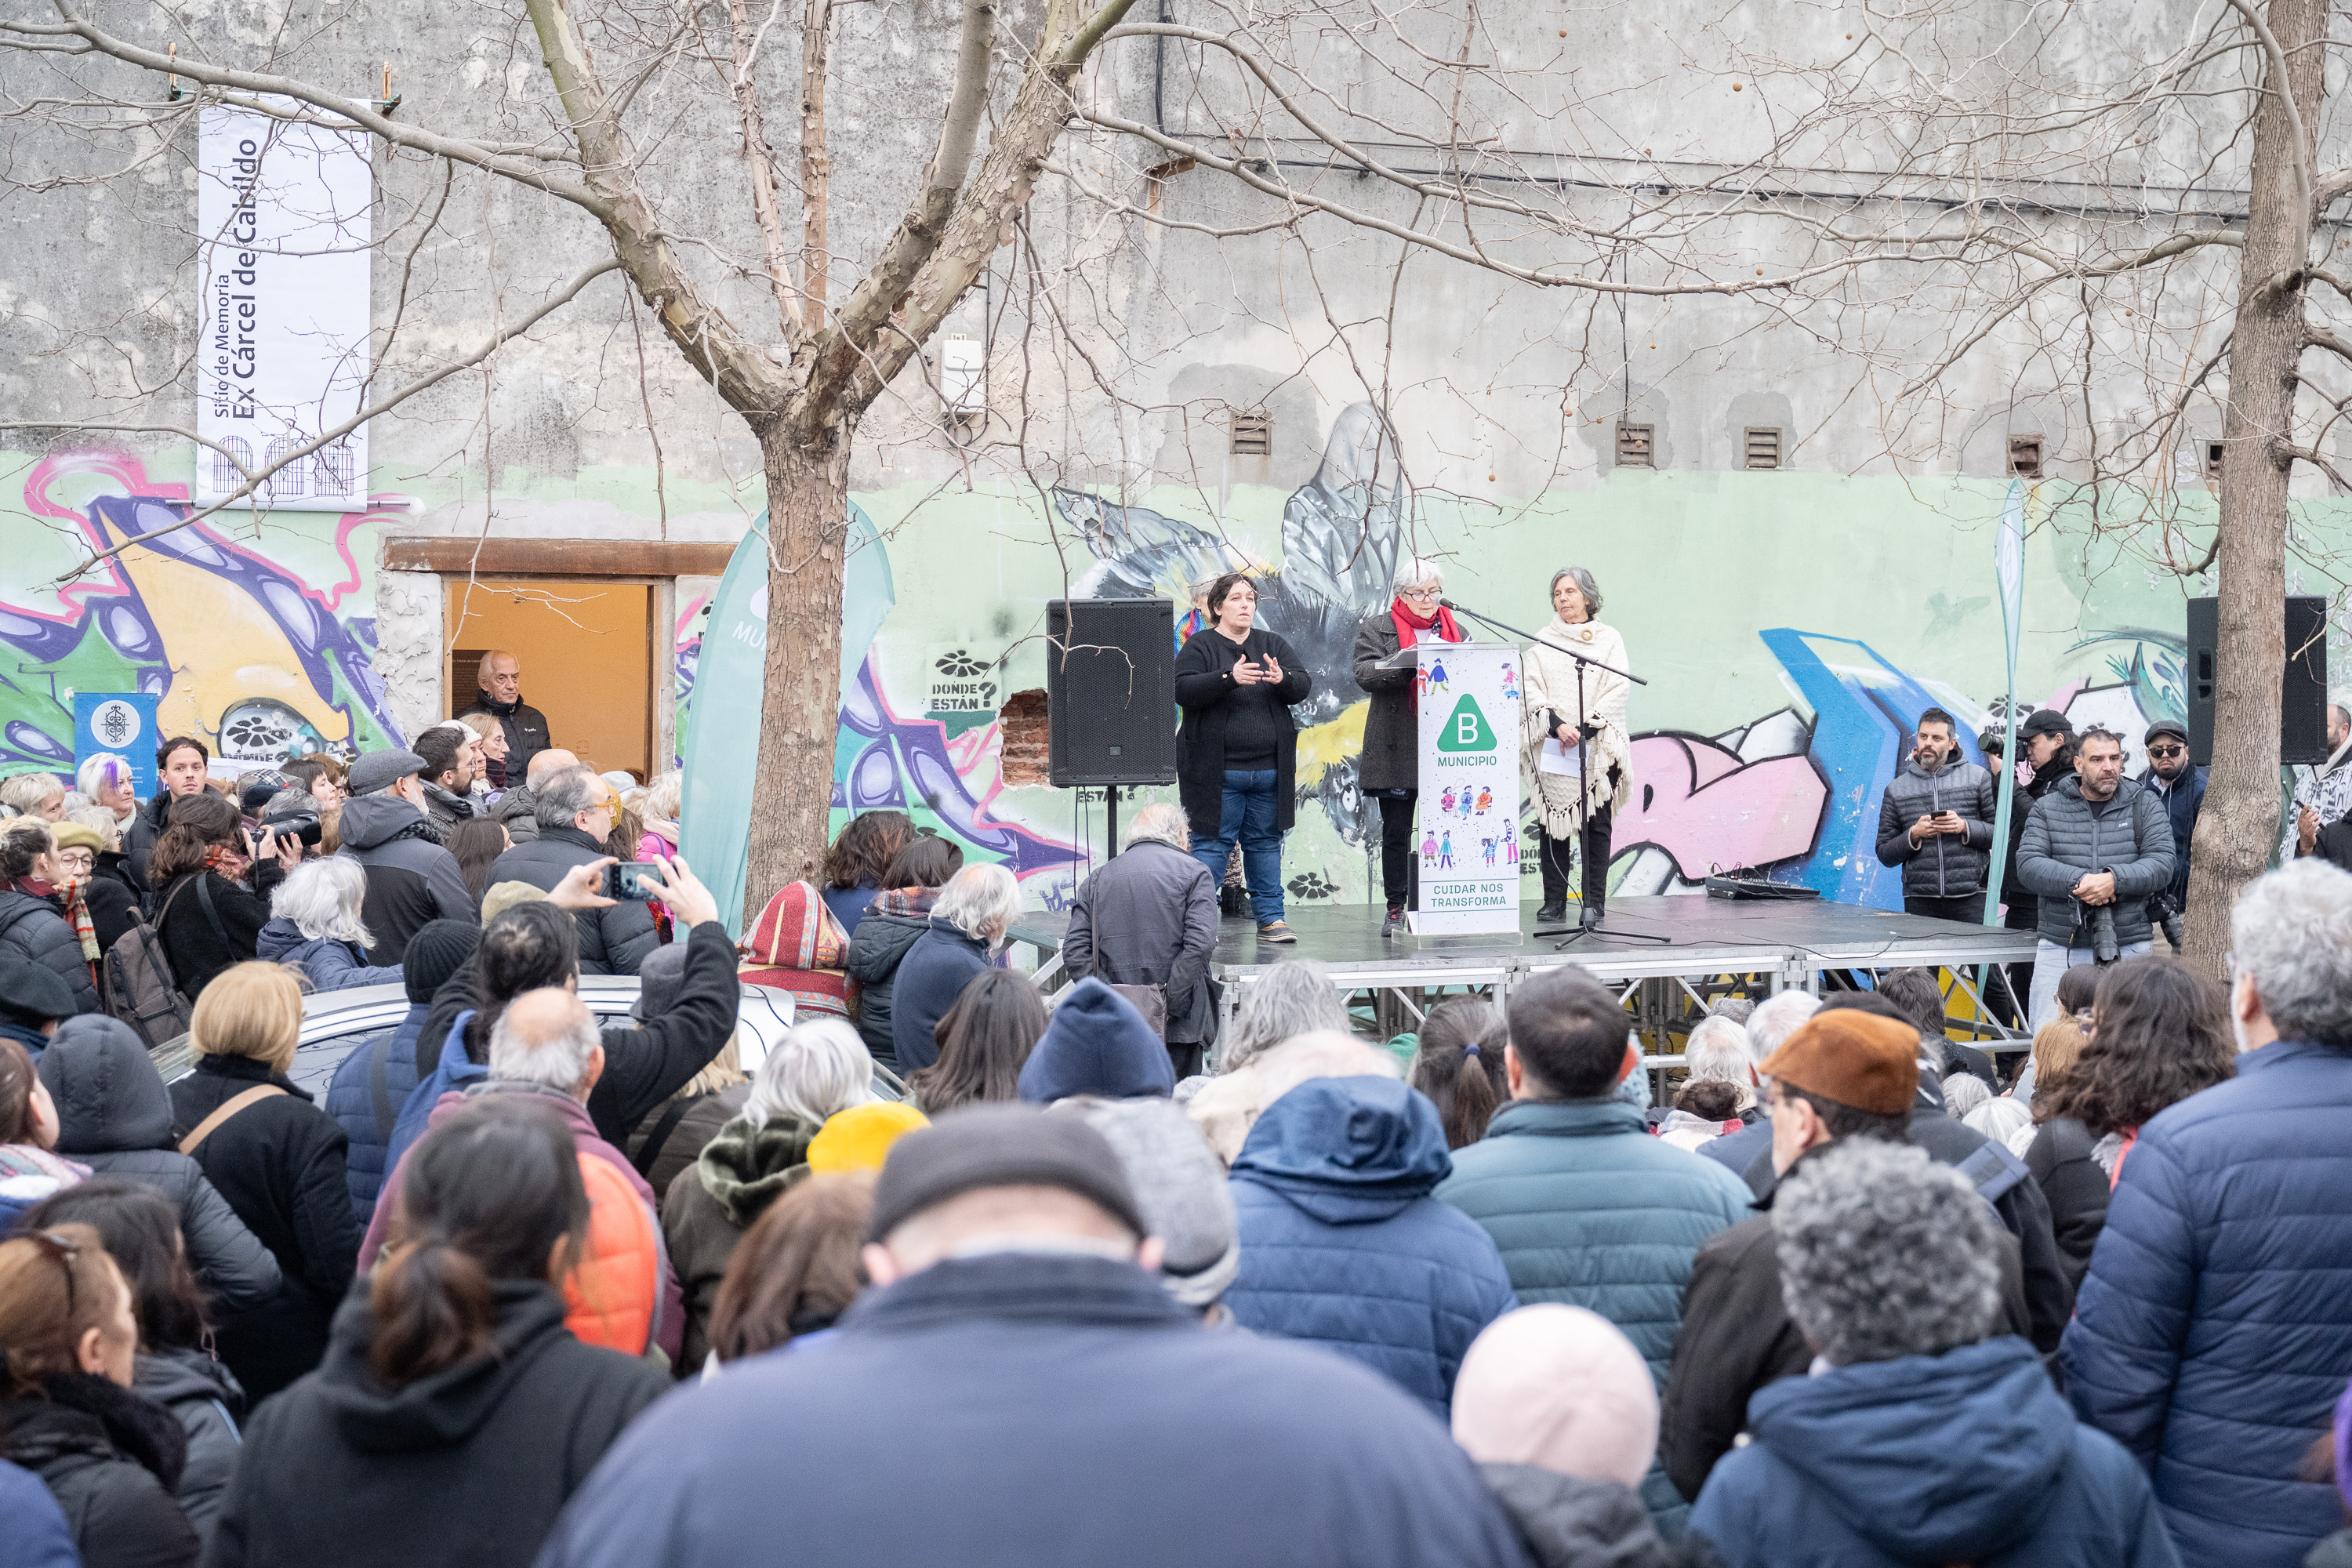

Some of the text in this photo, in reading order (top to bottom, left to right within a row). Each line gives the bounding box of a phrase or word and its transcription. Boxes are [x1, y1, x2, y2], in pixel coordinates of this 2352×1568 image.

[231, 139, 256, 419] Ex Cárcel de Cabildo
[215, 274, 229, 417] Sitio de Memoria
[931, 695, 978, 710] ESTÁN
[1457, 713, 1479, 745] B
[1437, 755, 1497, 767] MUNICIPIO
[1433, 883, 1504, 895] CUIDAR NOS
[1431, 895, 1506, 907] TRANSFORMA
